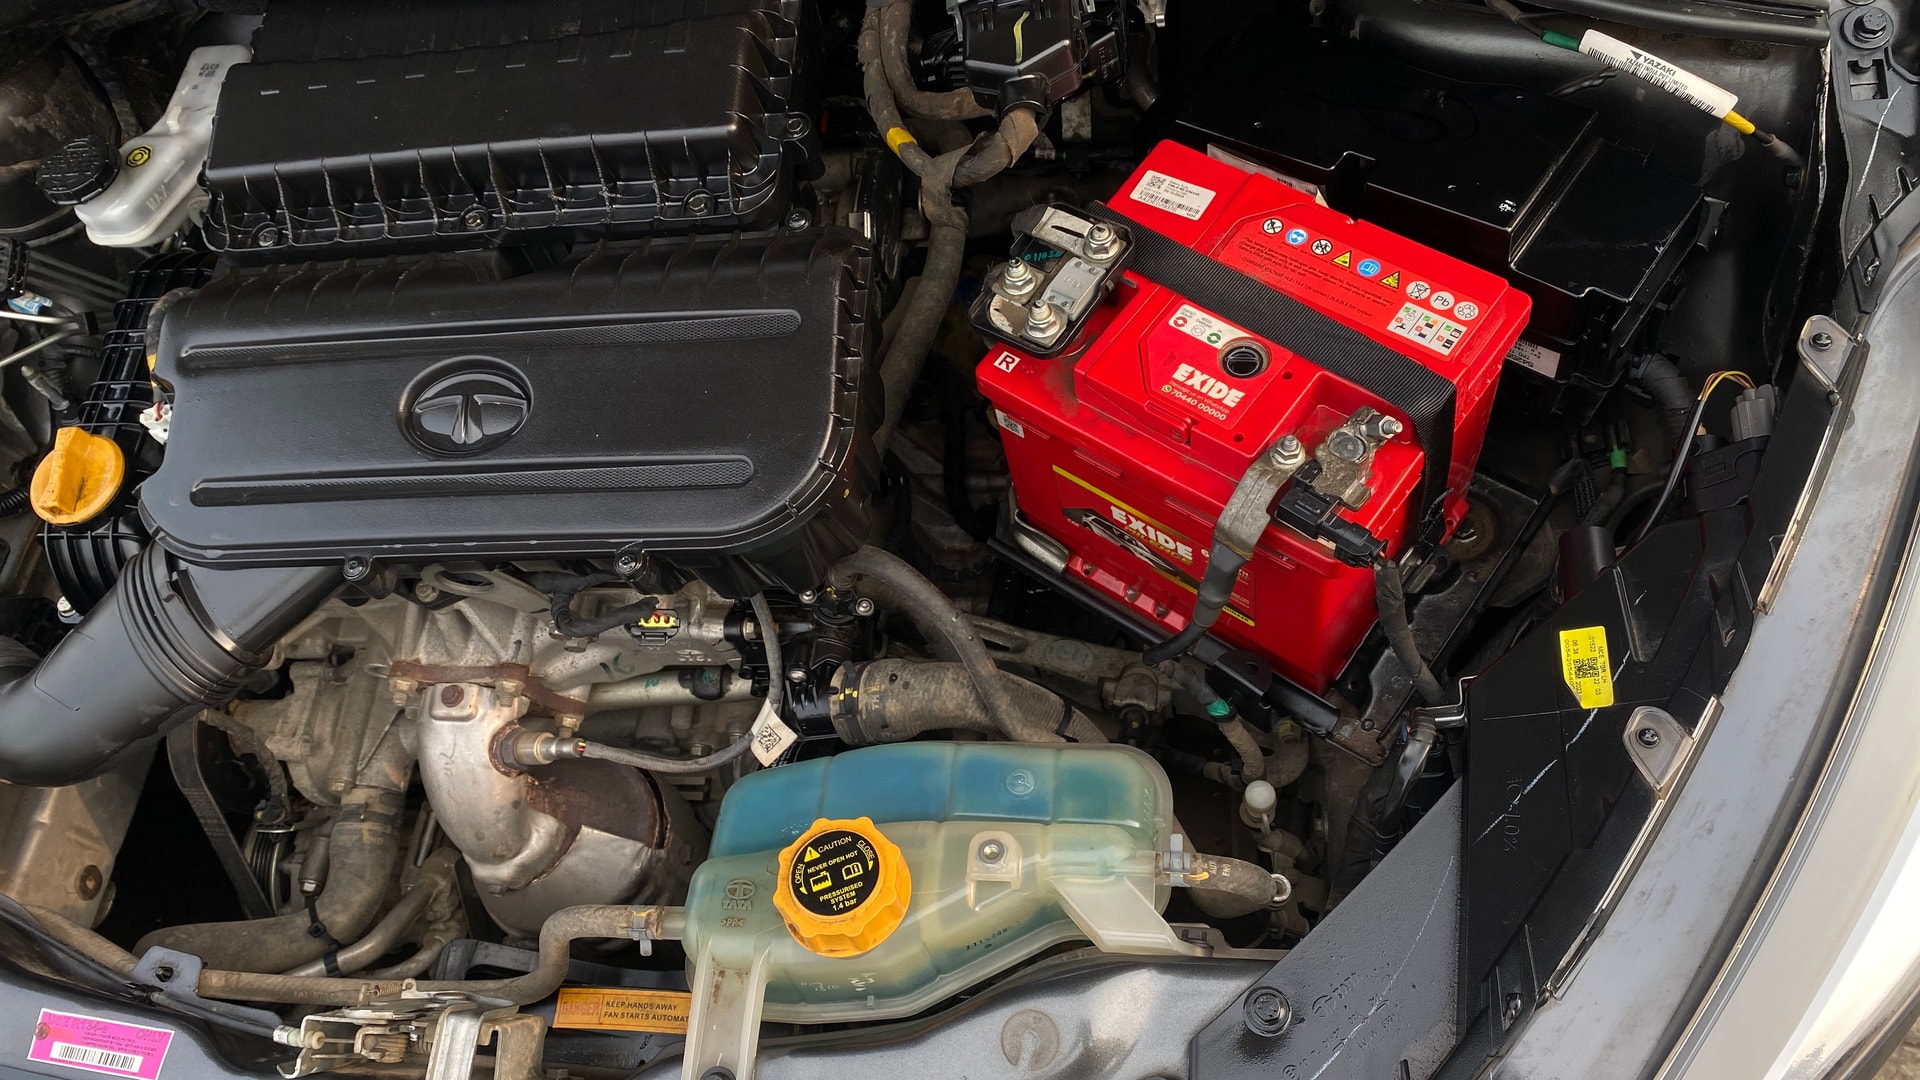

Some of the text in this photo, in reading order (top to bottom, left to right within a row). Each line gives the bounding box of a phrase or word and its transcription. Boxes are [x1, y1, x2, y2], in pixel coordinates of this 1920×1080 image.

[1625, 56, 1688, 90] YAZAKI INDIA PVT LIMITED
[1641, 55, 1676, 76] YAZAKI
[1433, 294, 1450, 307] Pb
[998, 354, 1016, 370] R
[1172, 362, 1246, 408] EXIDE
[1171, 389, 1226, 421] 70440 00000
[1110, 506, 1192, 560] EXIDE
[1601, 675, 1606, 683] LH
[818, 836, 852, 853] CAUTION
[857, 840, 875, 859] CLOSE
[807, 850, 858, 874] NEVER OPEN HOT
[794, 864, 804, 884] OPEN
[820, 881, 863, 902] PRESSURISED
[830, 890, 856, 904] SYSTEM
[722, 899, 752, 910] TATA
[832, 898, 857, 911] 1.4 bar
[626, 1002, 654, 1010] HANDS
[620, 1012, 650, 1020] STARTS
